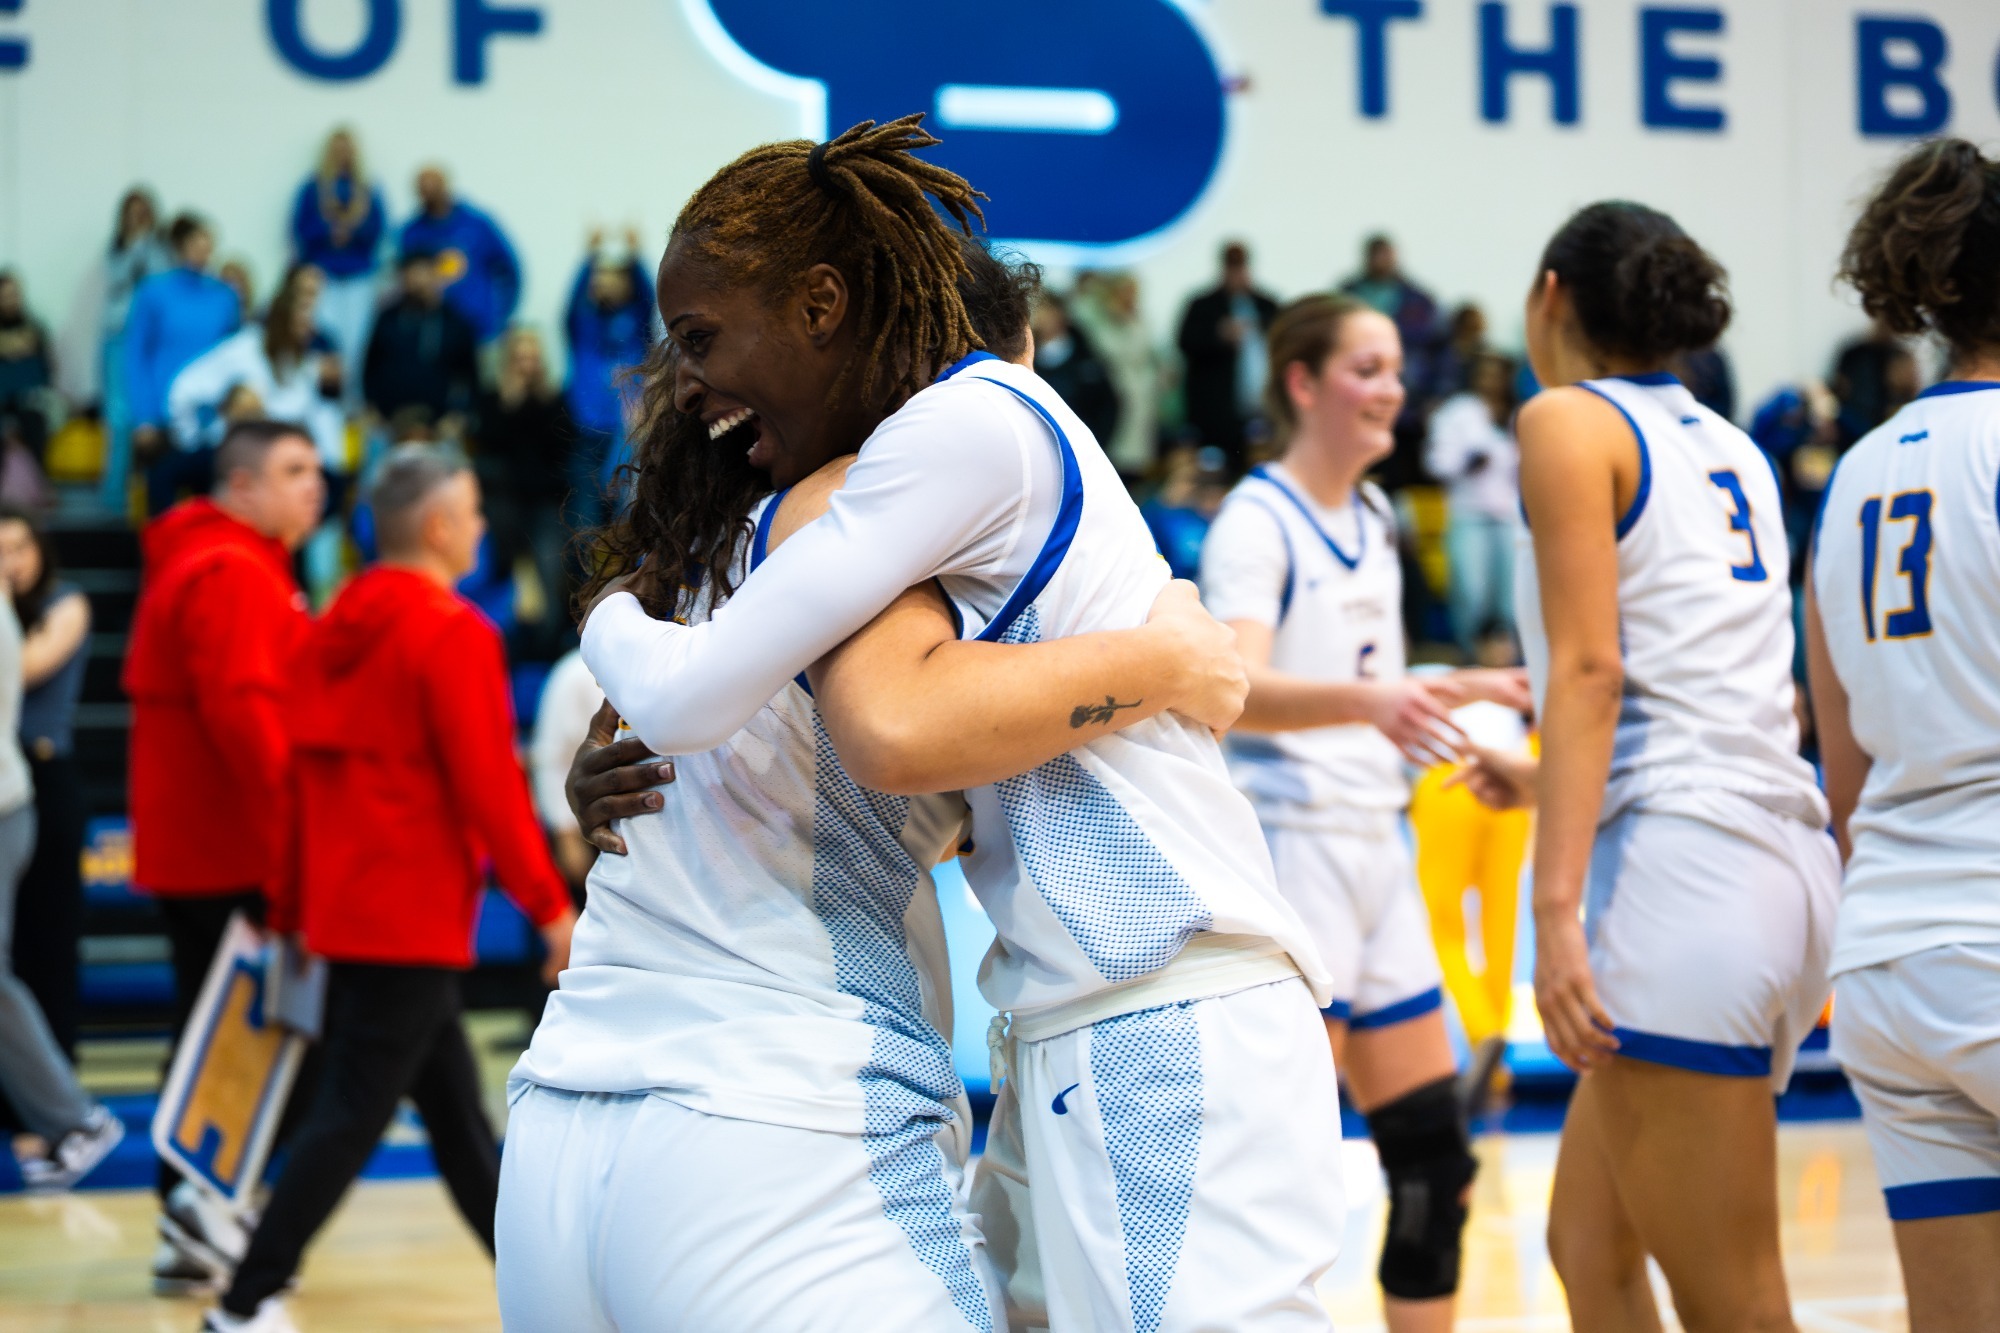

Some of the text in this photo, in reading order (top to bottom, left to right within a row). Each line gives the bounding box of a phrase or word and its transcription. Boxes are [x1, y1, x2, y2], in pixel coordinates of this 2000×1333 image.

[265, 0, 545, 85] OF
[1317, 0, 1728, 132] THE
[1854, 15, 2000, 137] B
[1707, 467, 1769, 583] 3
[1858, 488, 1936, 643] 13
